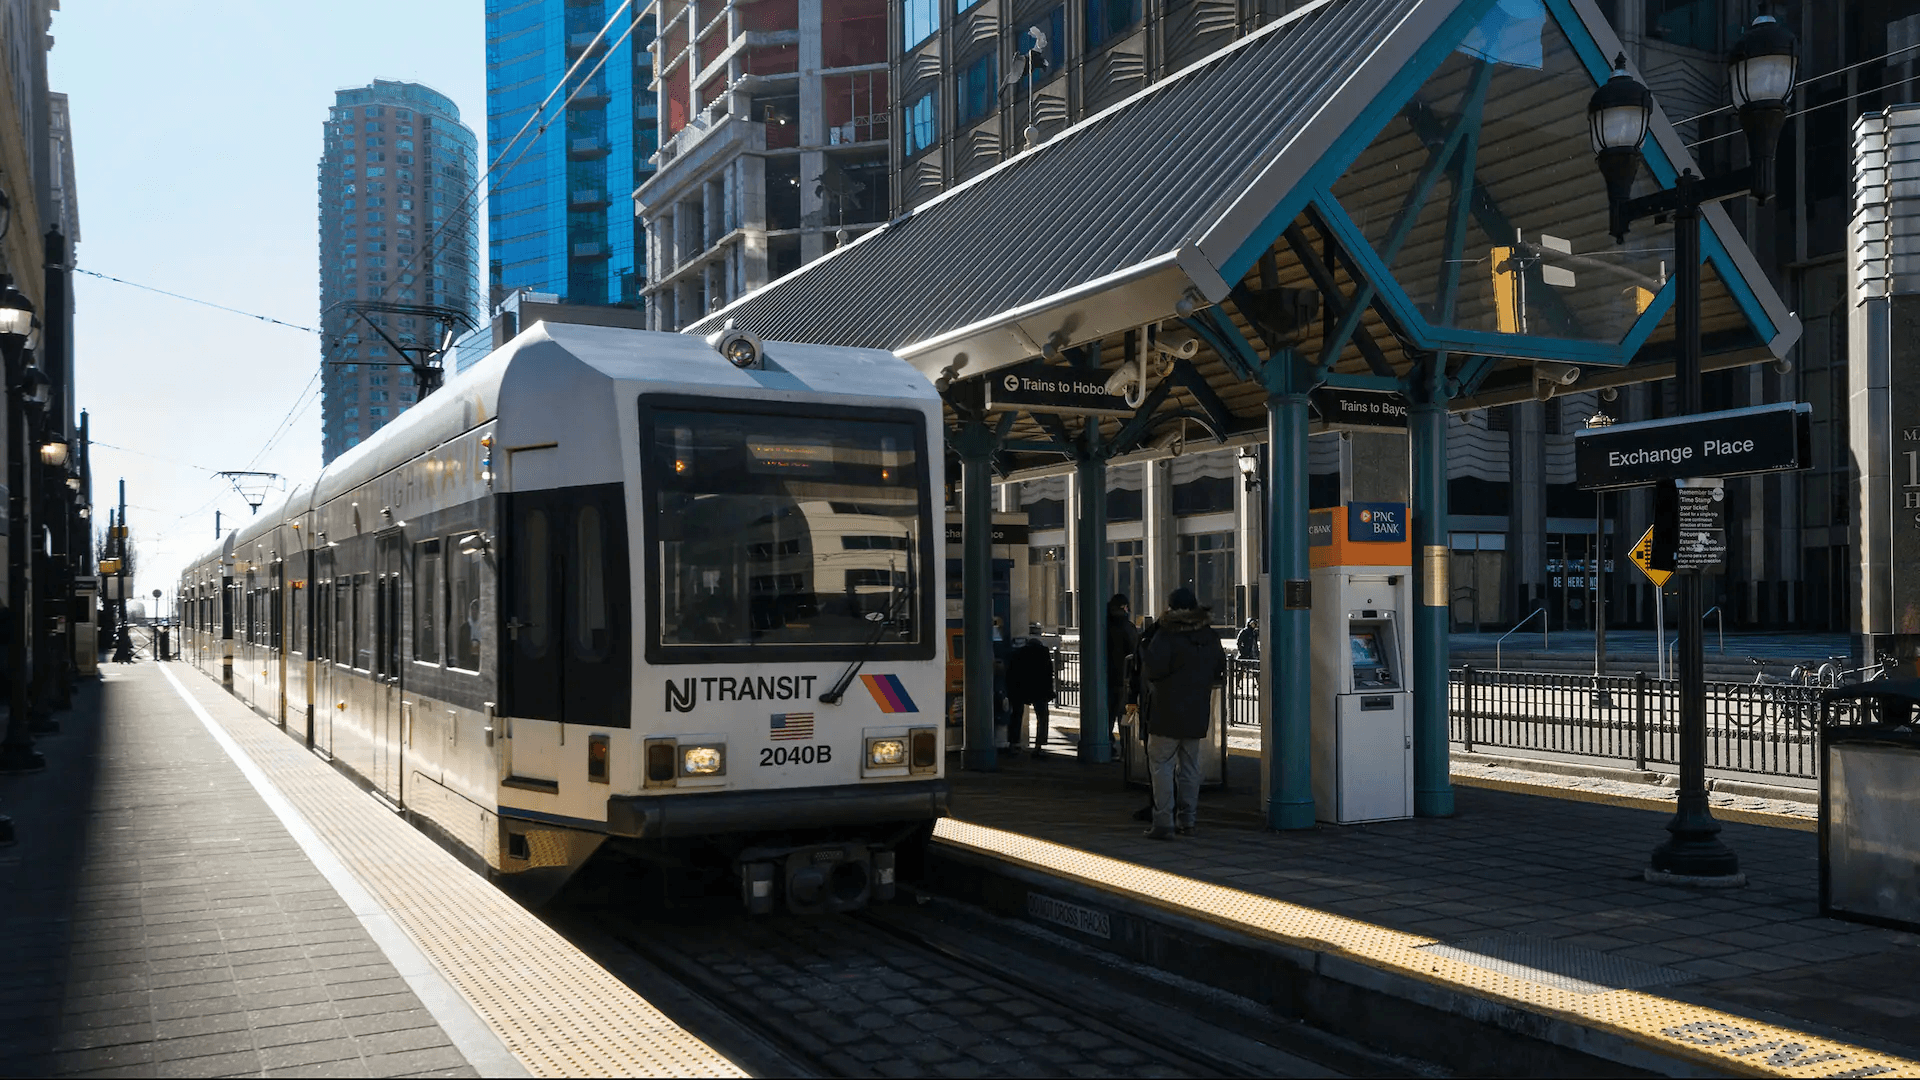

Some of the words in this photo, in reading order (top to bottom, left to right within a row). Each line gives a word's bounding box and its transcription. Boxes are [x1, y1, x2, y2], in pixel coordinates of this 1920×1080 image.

[1021, 378, 1056, 392] Trains
[1058, 381, 1070, 393] to
[1340, 400, 1368, 413] Trains
[1370, 402, 1380, 413] to
[1609, 446, 1693, 468] Exchange
[1704, 439, 1754, 456] Place
[1372, 511, 1395, 522] PNC
[1313, 524, 1332, 534] BANK
[1373, 523, 1399, 534] BANK
[1553, 576, 1562, 588] BE
[1567, 576, 1585, 588] HERE
[1589, 576, 1598, 588] NO
[701, 675, 817, 702] TRANSIT
[759, 745, 832, 767] 2040B
[1054, 901, 1079, 926] CROSS
[1079, 908, 1109, 936] TRACKS
